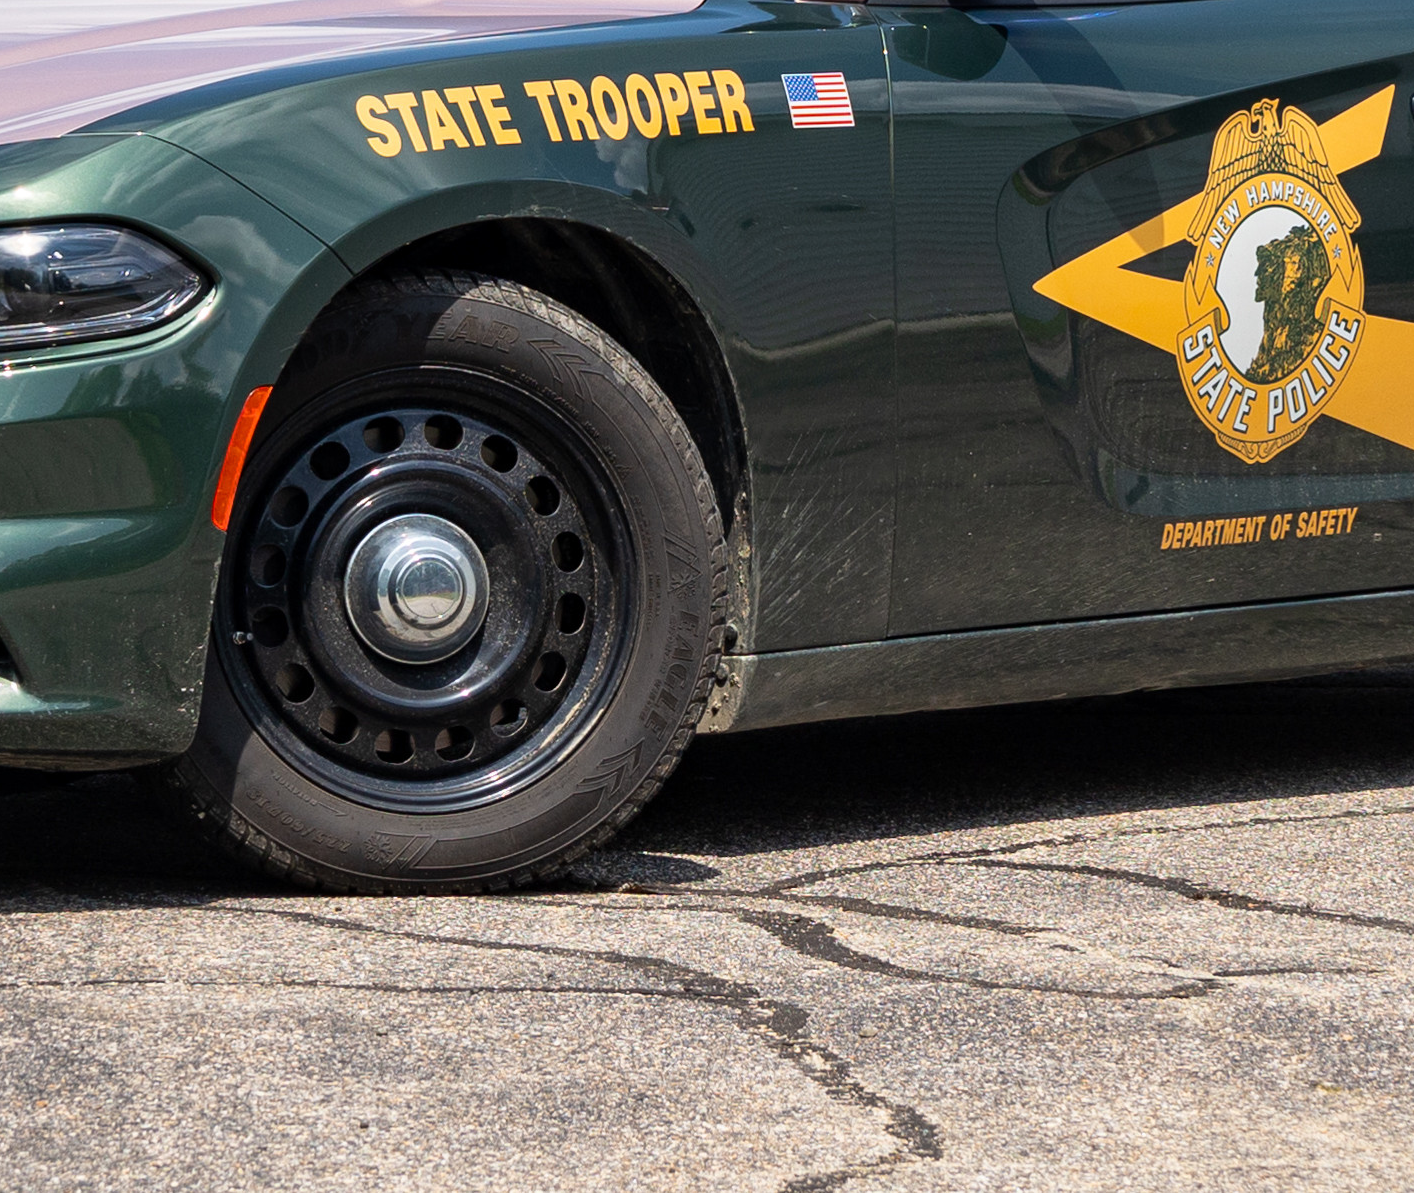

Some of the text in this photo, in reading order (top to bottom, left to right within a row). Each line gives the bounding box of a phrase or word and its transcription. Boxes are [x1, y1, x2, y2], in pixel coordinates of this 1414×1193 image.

[354, 69, 756, 158] STATE TROOPER
[1208, 180, 1338, 250] NEW HAMPSHIRE
[1183, 310, 1361, 433] STATE POLICE
[1160, 507, 1359, 550] DEPARTMENT OF SAFETY
[644, 610, 700, 743] EAGLE
